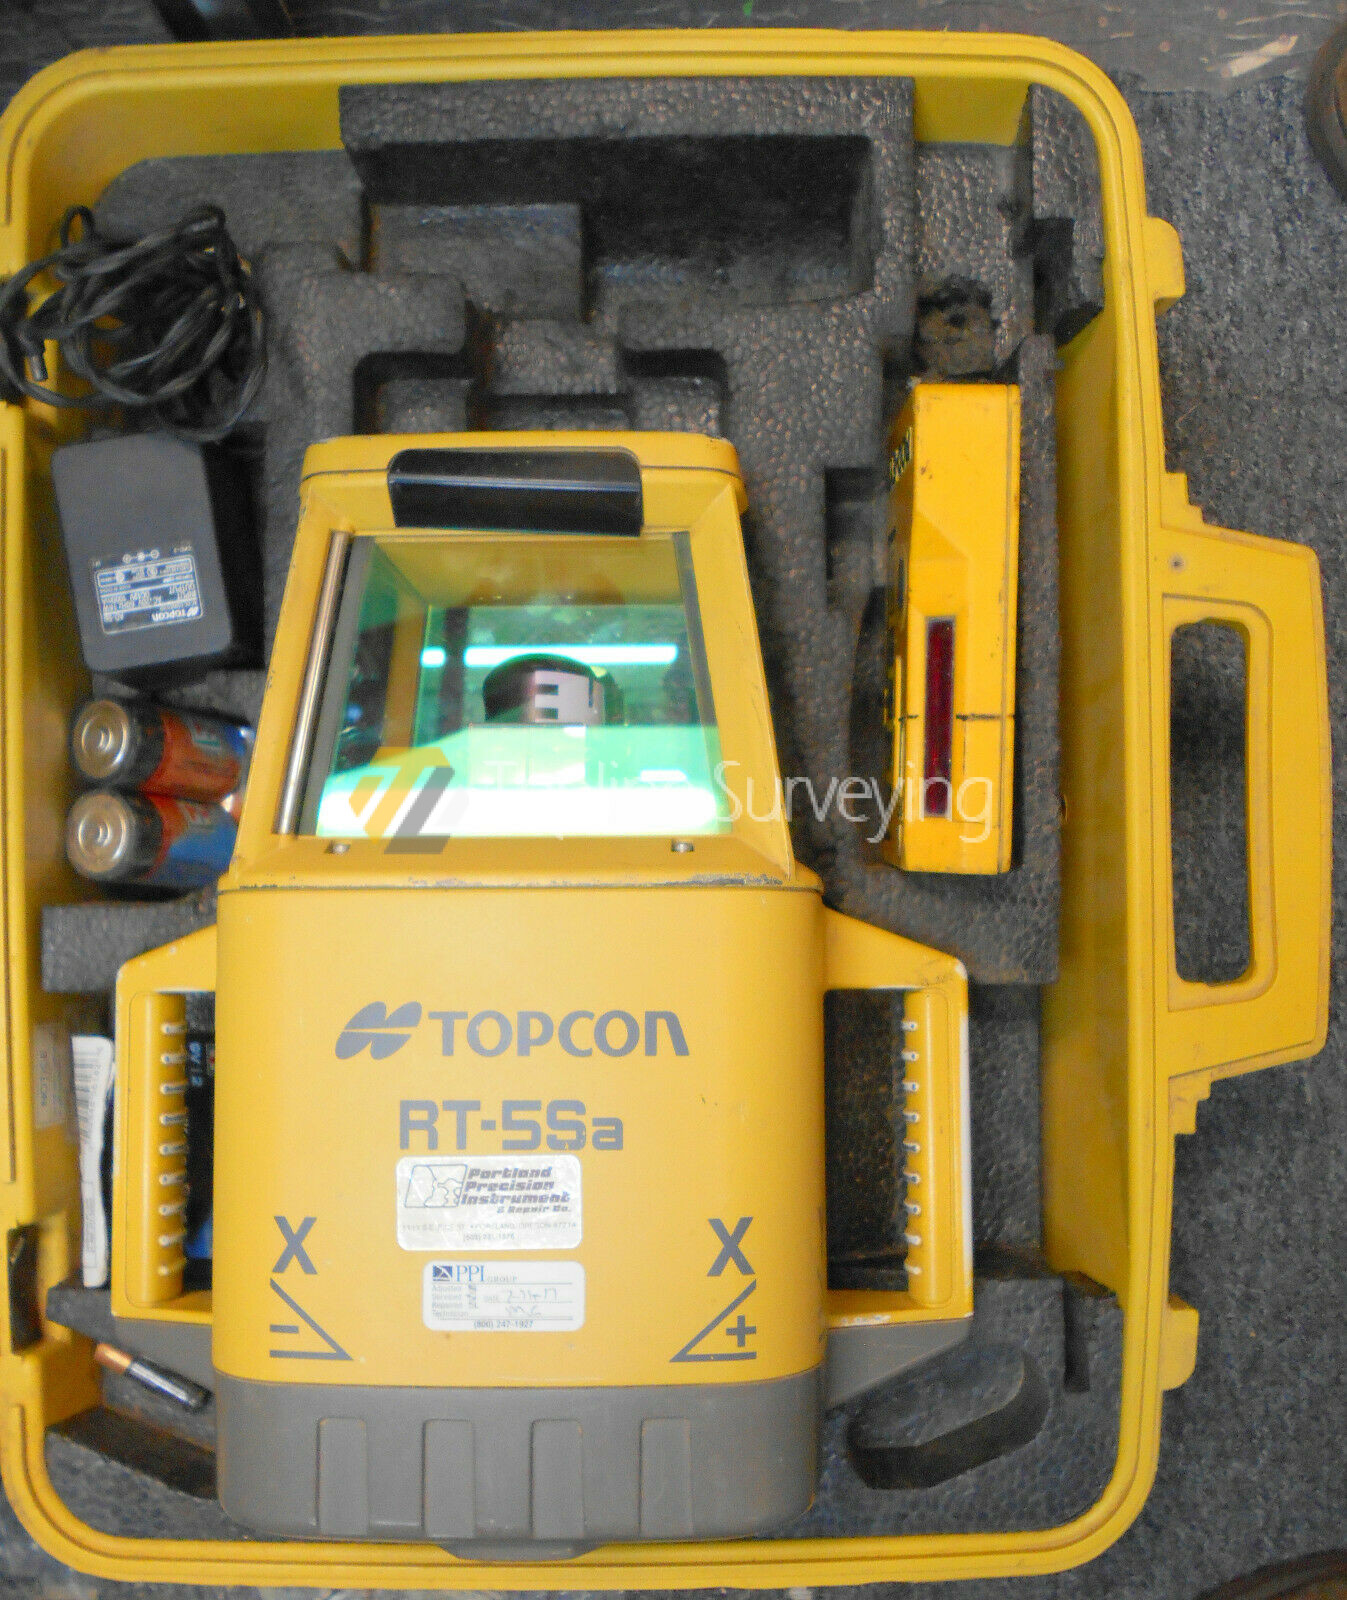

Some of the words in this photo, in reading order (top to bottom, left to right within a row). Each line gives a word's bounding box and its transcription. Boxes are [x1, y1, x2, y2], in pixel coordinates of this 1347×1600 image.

[151, 609, 187, 622] TOPCON
[428, 1009, 690, 1057] TOPCON
[400, 1100, 623, 1150] RT-5Sa
[468, 1166, 552, 1179] Portland
[465, 1180, 554, 1192] Precision
[461, 1191, 570, 1205] Instrument
[272, 1216, 318, 1275] X
[707, 1216, 755, 1277] X
[456, 1265, 485, 1282] PPI
